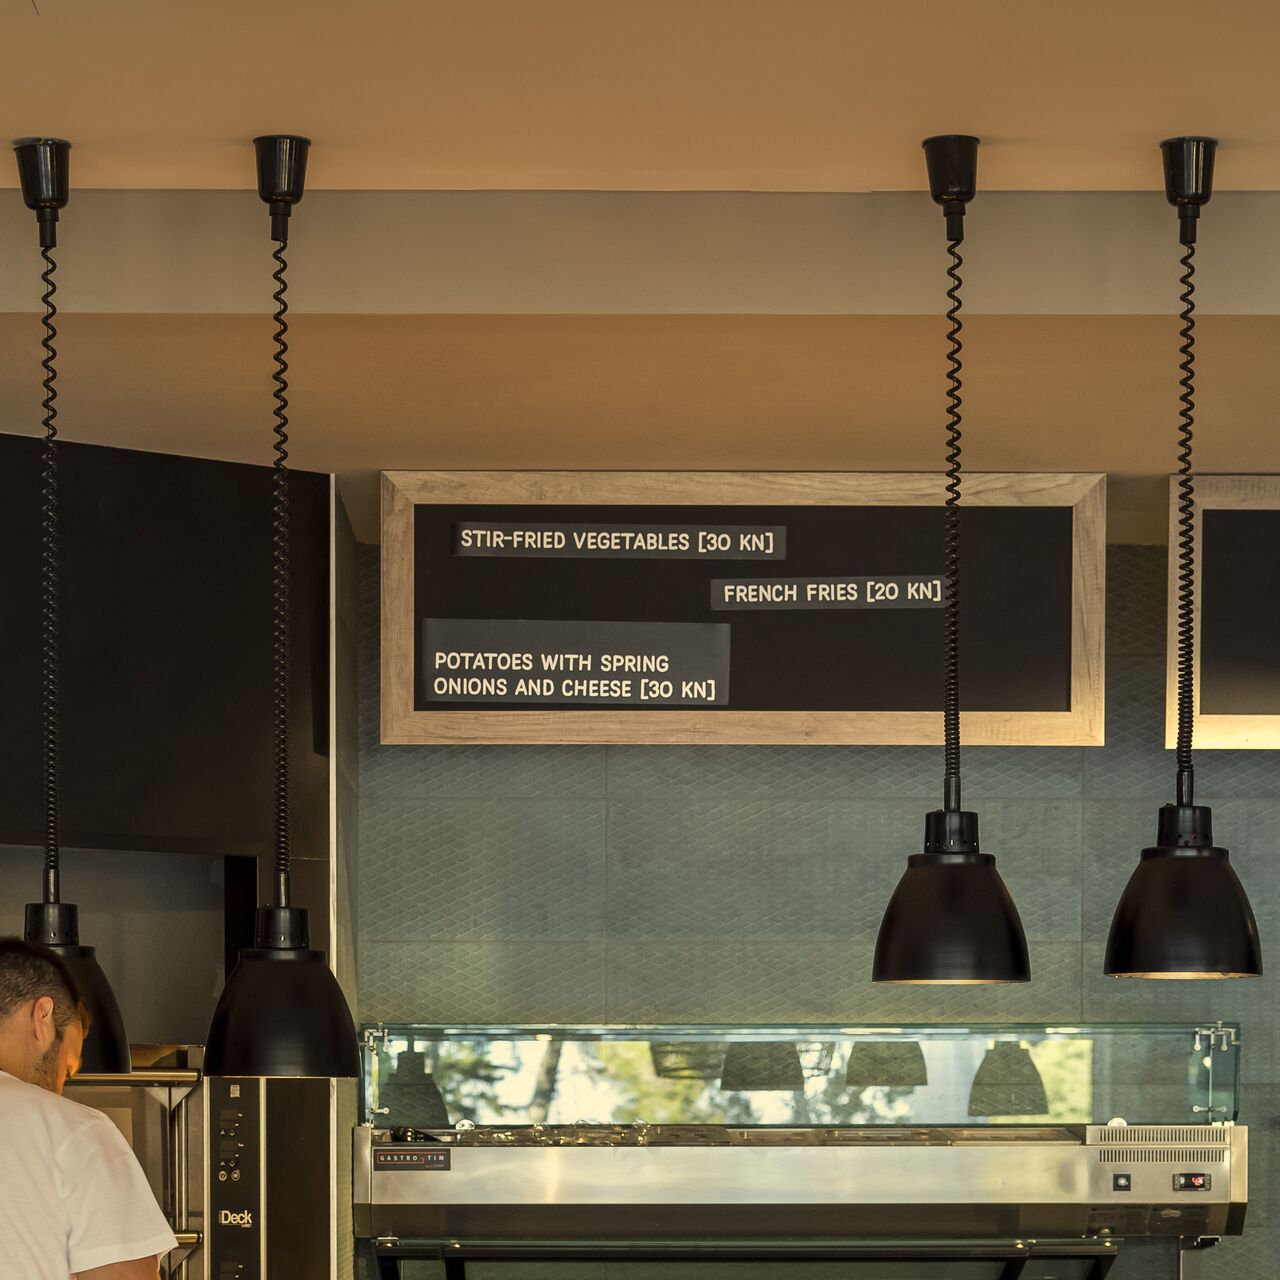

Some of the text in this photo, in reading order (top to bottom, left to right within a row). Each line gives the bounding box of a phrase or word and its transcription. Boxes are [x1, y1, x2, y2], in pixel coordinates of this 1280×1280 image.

[462, 530, 773, 553] STIR-FRIED VEGETABLES [30 KN]
[725, 580, 941, 602] FRENCH FRIES [20 KN]
[436, 652, 668, 672] POTATOES WITH SPRING
[434, 678, 715, 701] ONIONS AND CHEESE [30 KN]
[220, 1210, 253, 1224] Deck
